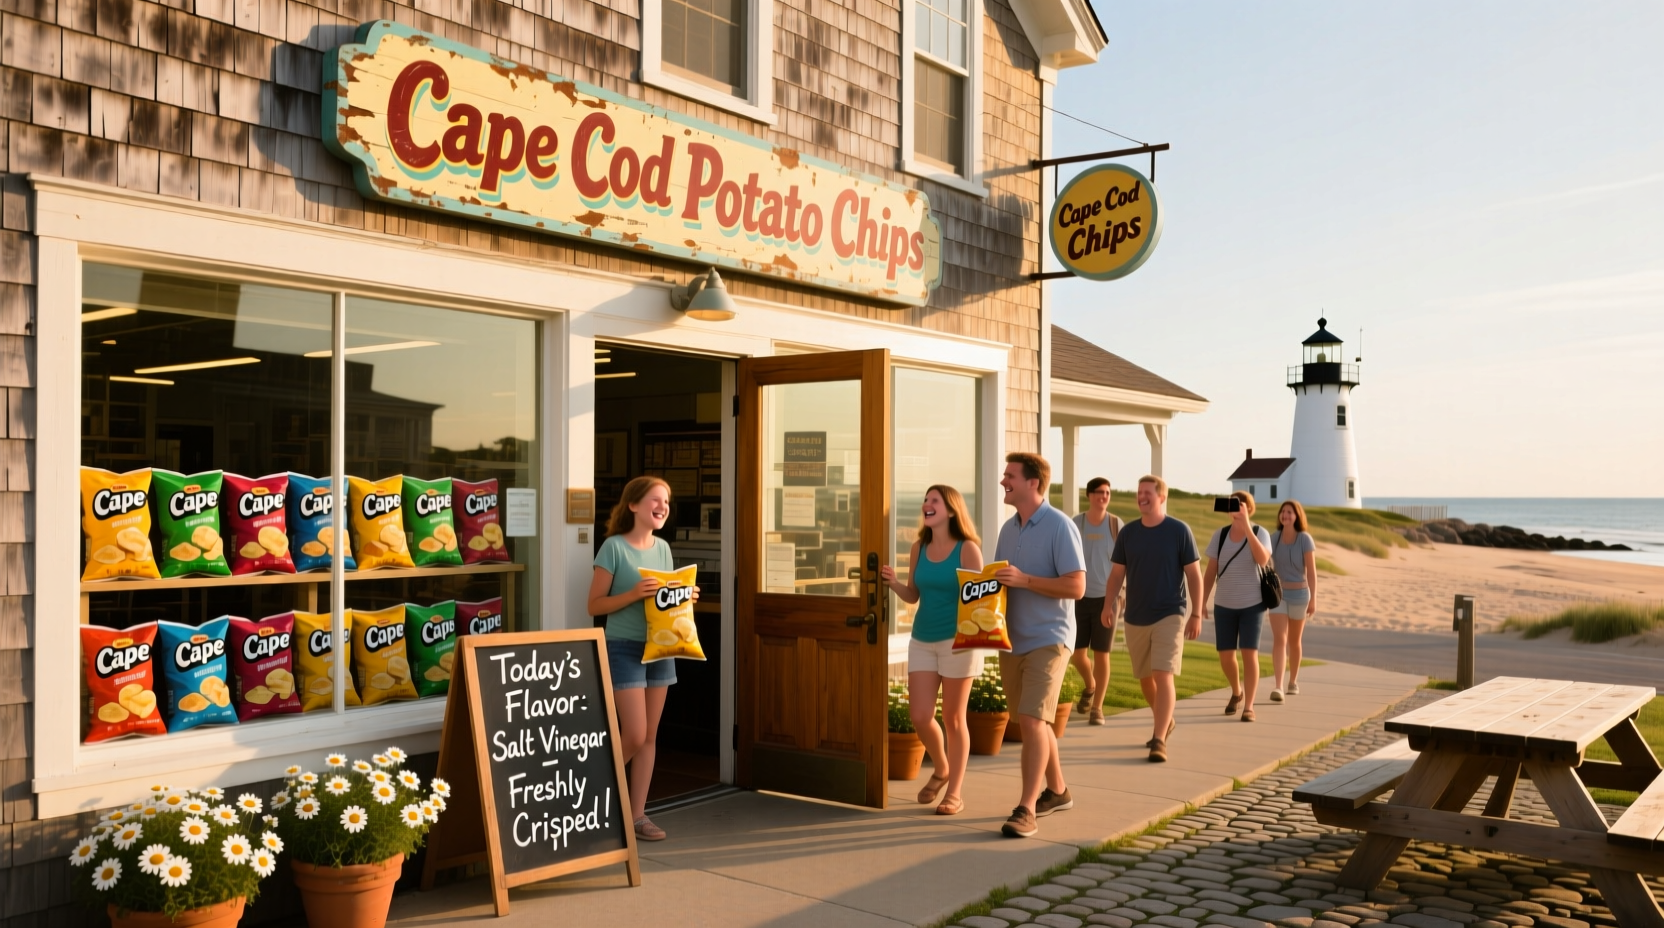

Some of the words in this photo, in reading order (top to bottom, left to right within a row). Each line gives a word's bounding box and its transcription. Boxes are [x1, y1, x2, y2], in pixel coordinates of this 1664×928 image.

[386, 60, 559, 192] Cape
[570, 112, 676, 208] Cod
[681, 142, 824, 248] Potato
[831, 188, 926, 281] Chips
[1058, 200, 1102, 228] Cape
[1105, 180, 1141, 211] Cod
[1067, 216, 1142, 260] Chips
[94, 490, 146, 516] Cape
[170, 490, 218, 516] Cape
[239, 492, 286, 516] Cape
[300, 493, 347, 516] Cap
[363, 494, 402, 516] Cape
[416, 493, 452, 516] Cape
[962, 580, 998, 602] Cape
[243, 633, 290, 660] Cape
[366, 624, 404, 648] Cape
[96, 644, 150, 675] Cape
[175, 639, 225, 668] Cape
[489, 649, 582, 692] Today's
[505, 688, 588, 723] Flavor:
[492, 728, 535, 762] Salt
[538, 724, 607, 762] Vinegar
[508, 768, 587, 809] Freshly
[512, 786, 611, 850] Crisped!
